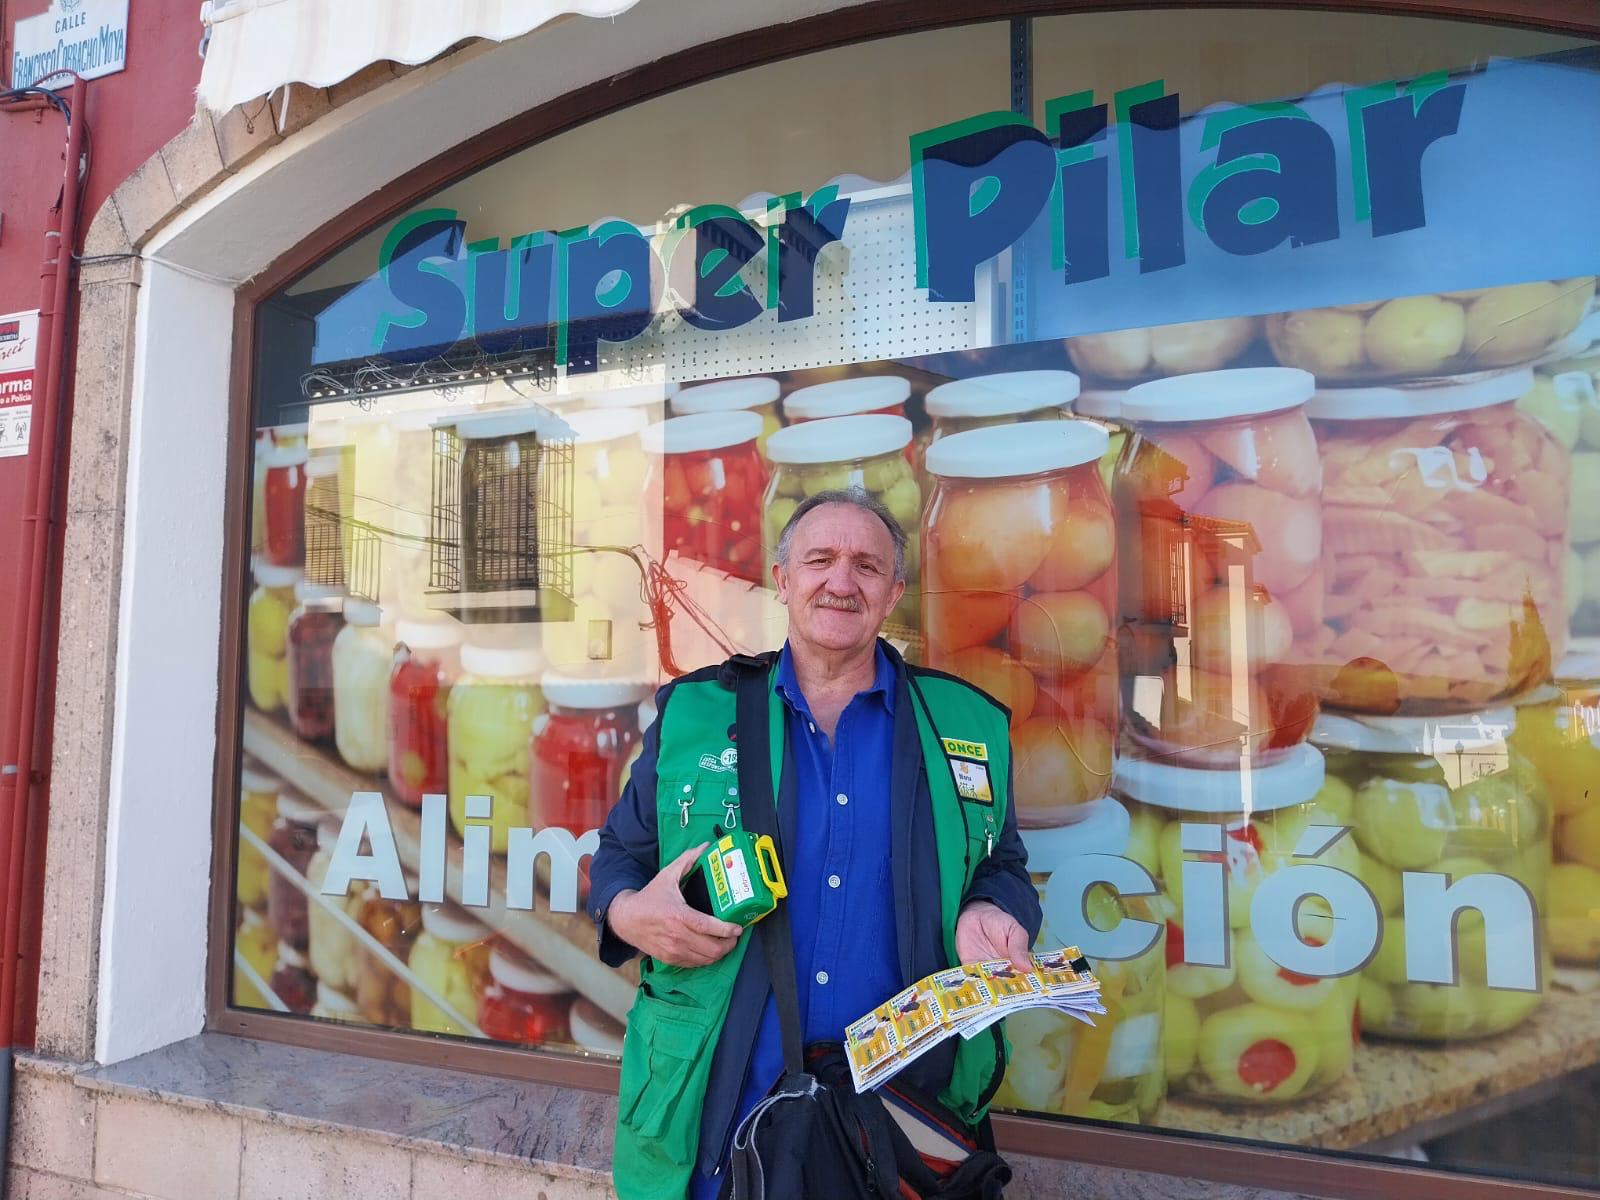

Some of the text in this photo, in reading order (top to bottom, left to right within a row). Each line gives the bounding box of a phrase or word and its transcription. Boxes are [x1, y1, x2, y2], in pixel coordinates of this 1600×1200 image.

[55, 12, 86, 33] CALLE
[14, 49, 56, 90] FRANCISCO
[98, 24, 124, 67] MOYA
[371, 69, 1467, 368] Super Pilar
[947, 741, 983, 757] ONCE
[320, 791, 1543, 994] Alimción
[711, 853, 725, 891] ONCE
